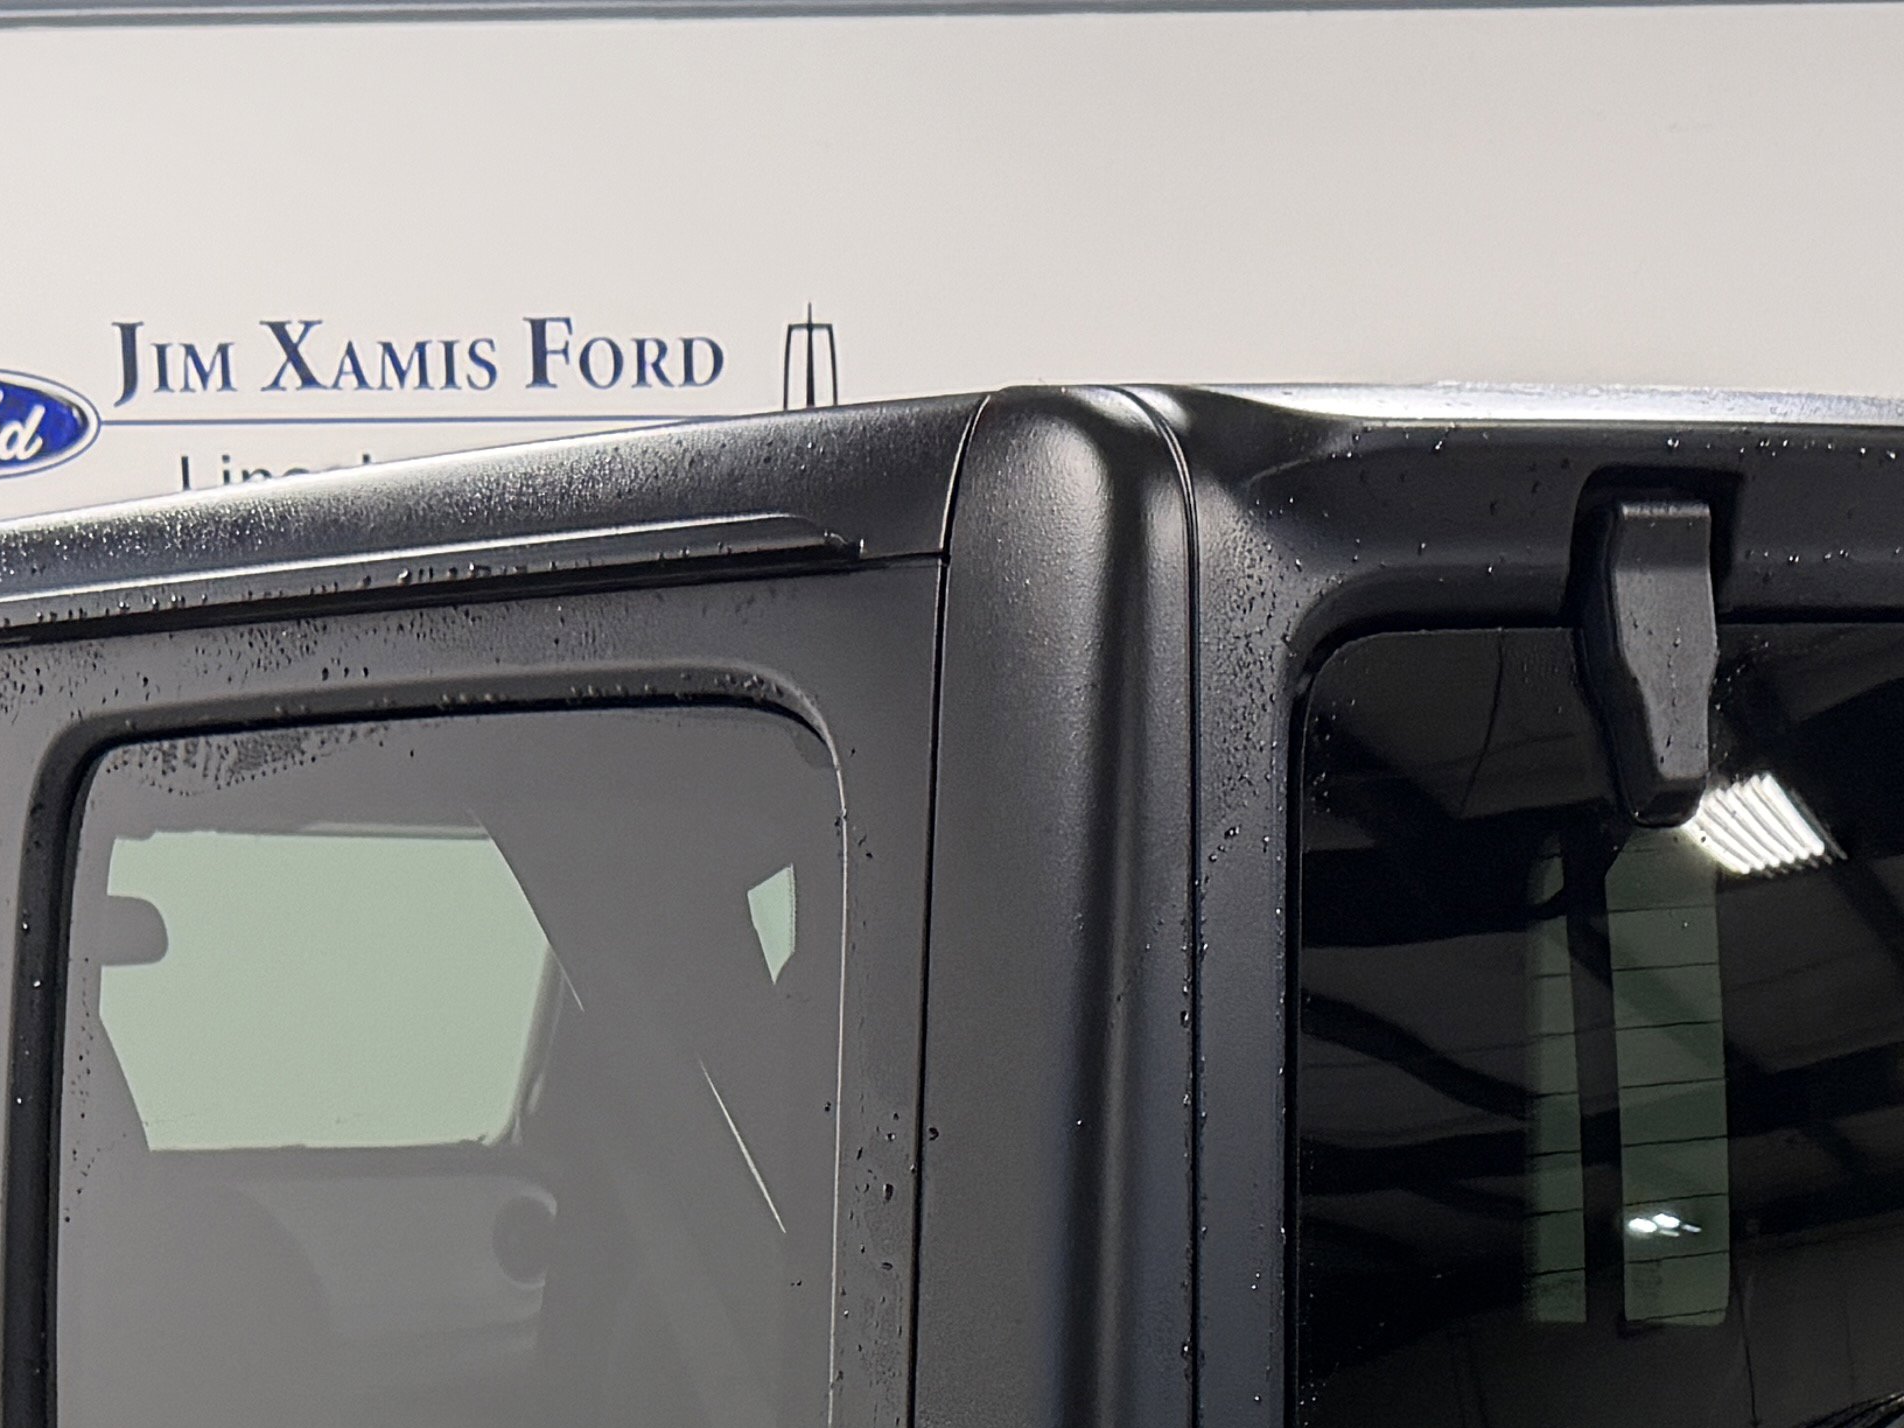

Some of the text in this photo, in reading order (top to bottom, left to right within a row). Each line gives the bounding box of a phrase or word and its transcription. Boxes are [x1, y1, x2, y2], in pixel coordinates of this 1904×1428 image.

[110, 316, 726, 408] JIM XAMIS FORD
